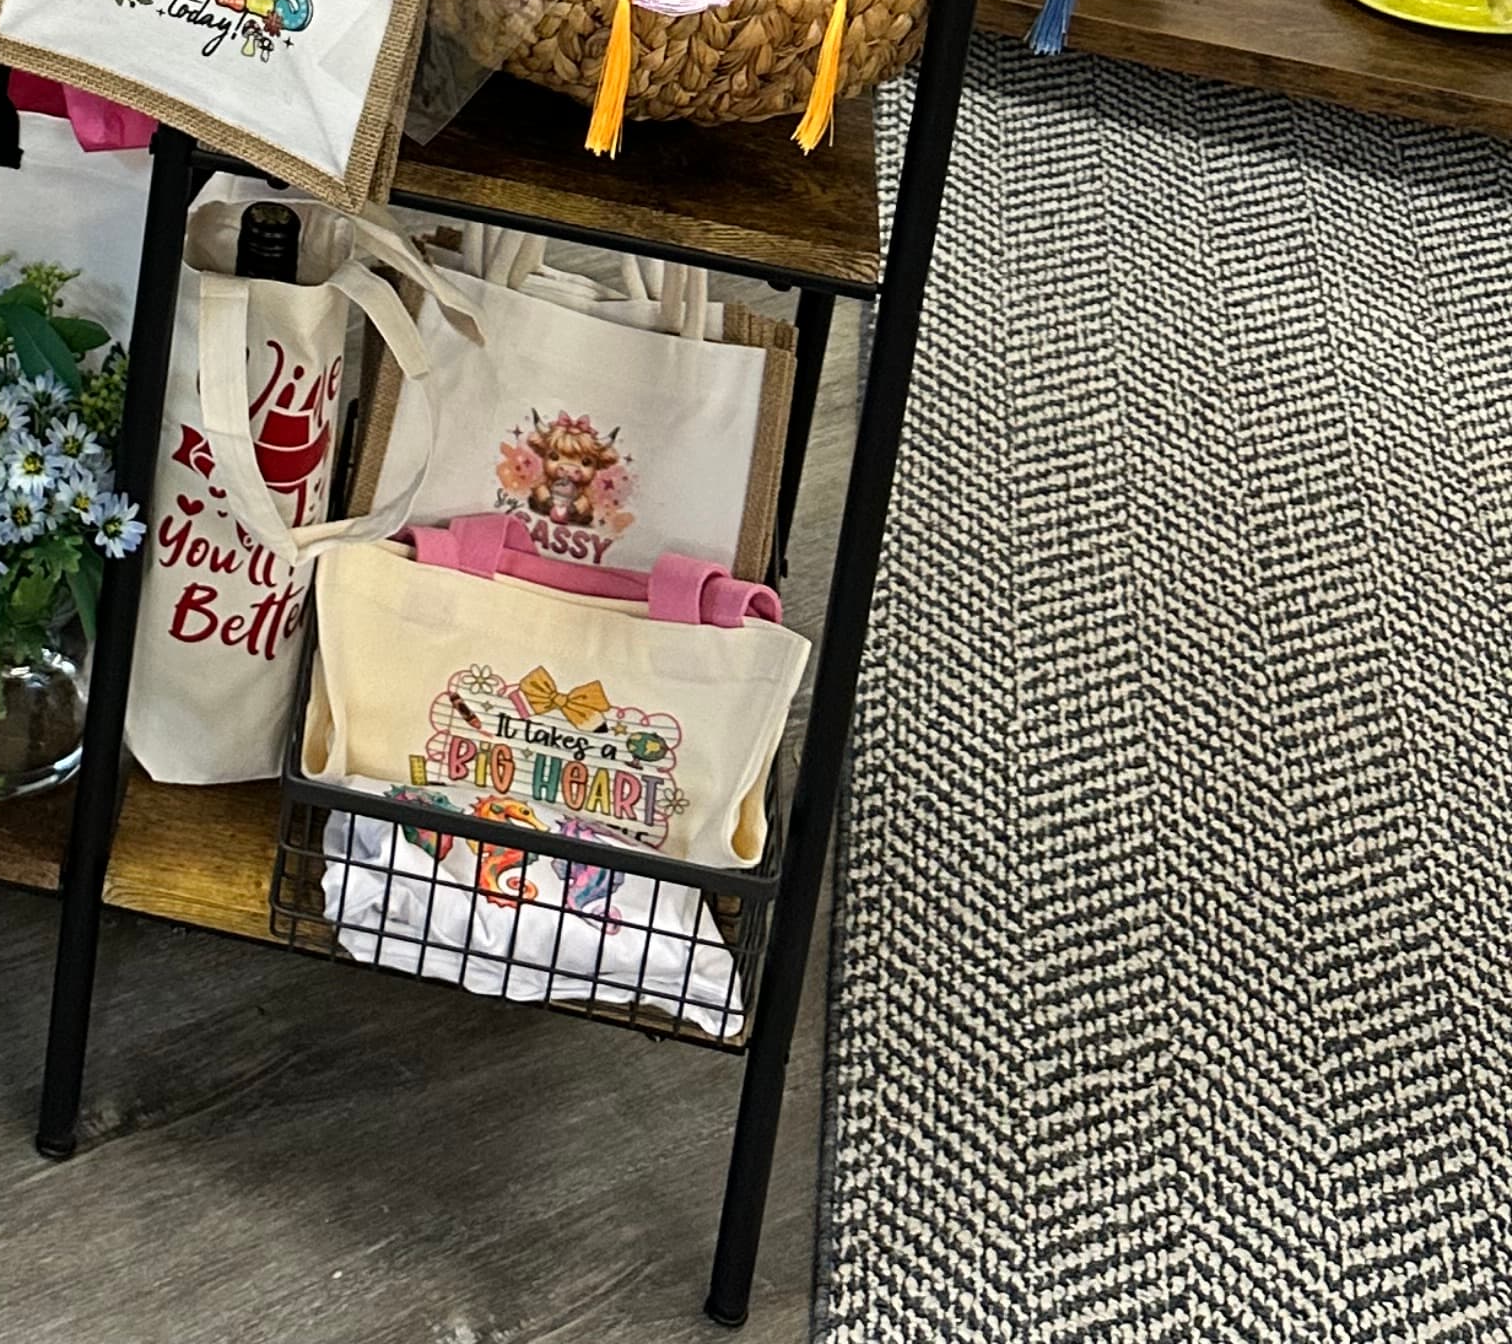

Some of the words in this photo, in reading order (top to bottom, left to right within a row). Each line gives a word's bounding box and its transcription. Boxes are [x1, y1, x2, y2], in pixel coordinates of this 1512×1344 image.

[494, 712, 519, 738] It
[523, 719, 596, 761] takes
[600, 743, 617, 761] a
